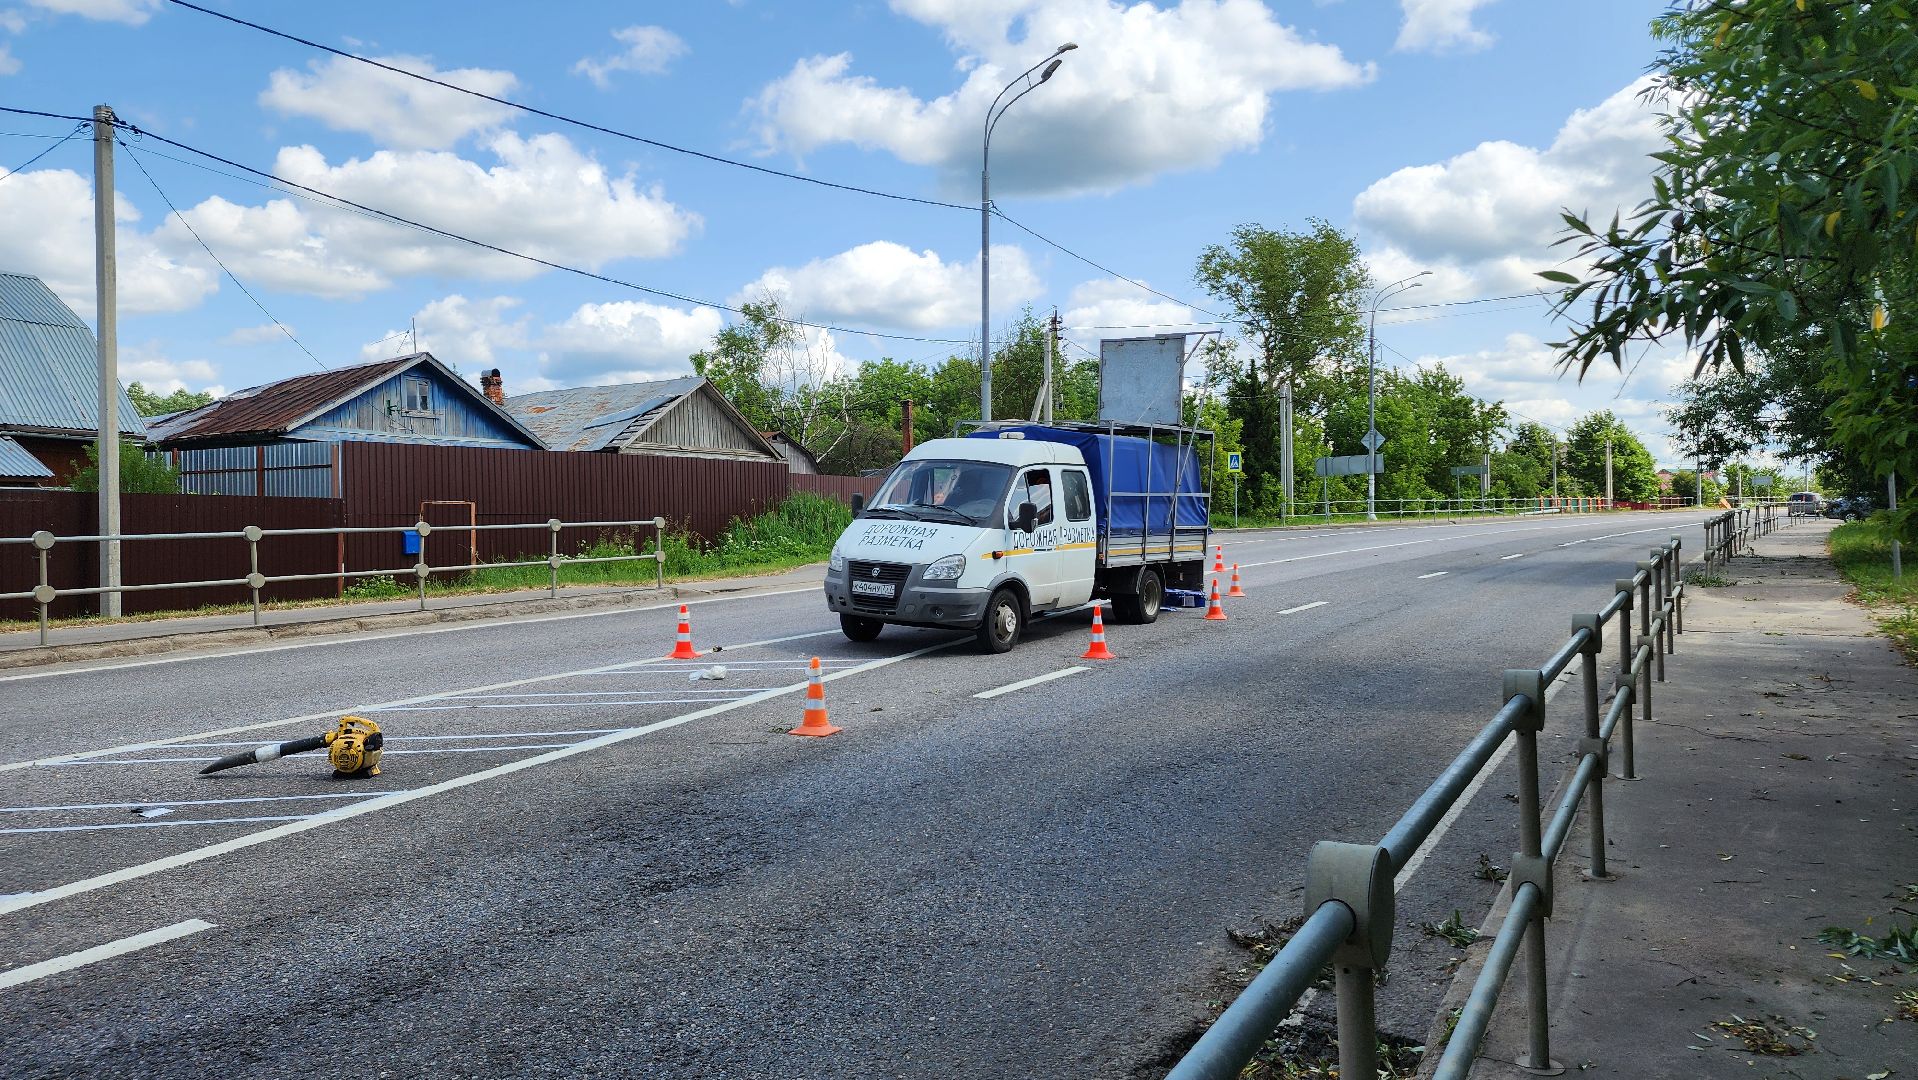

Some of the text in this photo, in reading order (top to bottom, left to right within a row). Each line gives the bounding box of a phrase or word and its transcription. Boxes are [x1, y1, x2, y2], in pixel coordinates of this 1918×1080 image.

[863, 524, 939, 539] ДОРОЖНАЯ
[1013, 526, 1096, 551] ДОРОЖНАЯ РАЗМЕТКА
[858, 535, 924, 551] РАЗМЕТКА
